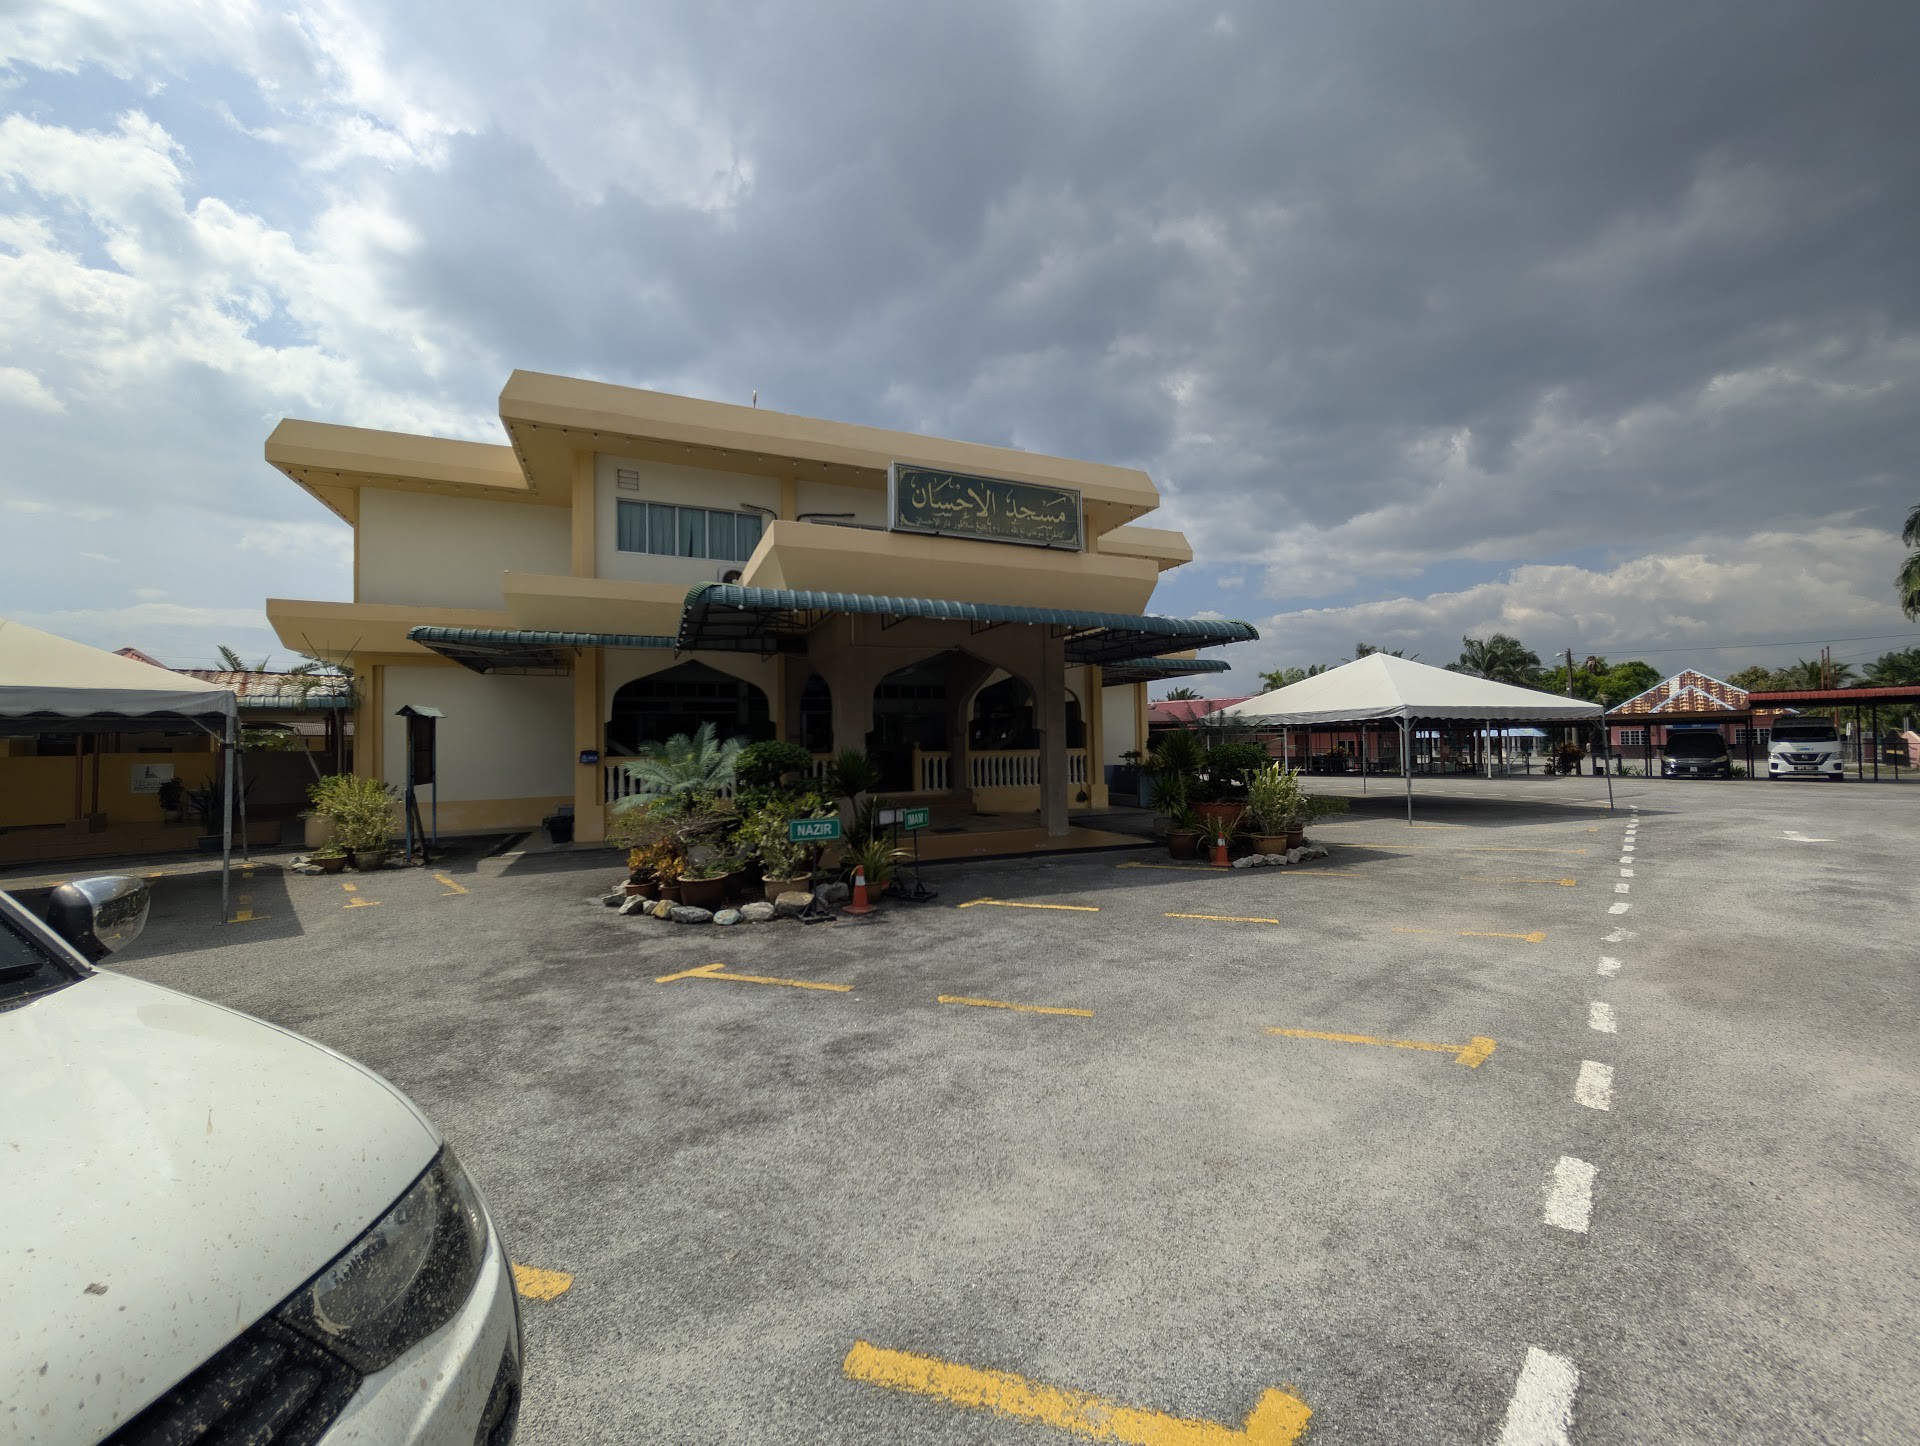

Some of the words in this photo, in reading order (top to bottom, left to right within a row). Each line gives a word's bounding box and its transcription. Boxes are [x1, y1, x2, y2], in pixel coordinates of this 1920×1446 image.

[1005, 490, 1067, 524] مسجد
[907, 812, 924, 826] IMAM
[797, 823, 832, 836] NAZIR
